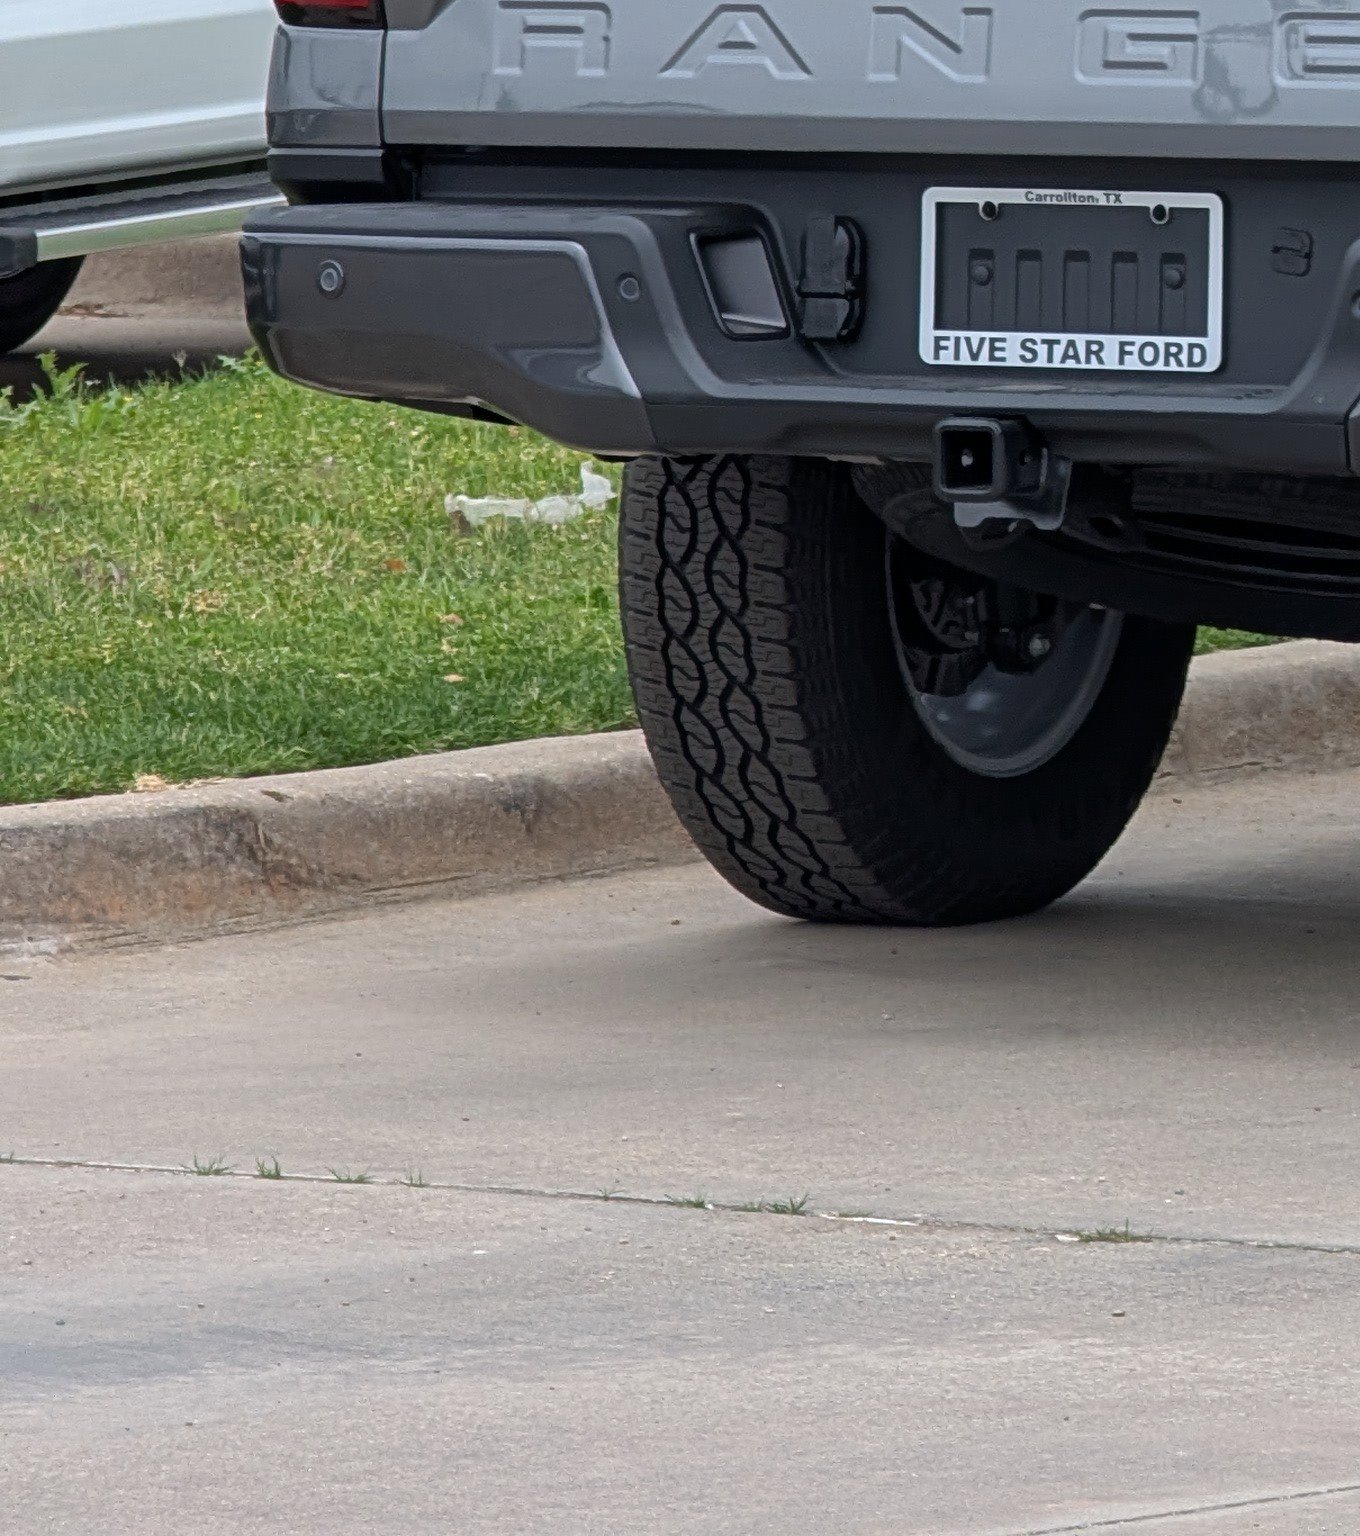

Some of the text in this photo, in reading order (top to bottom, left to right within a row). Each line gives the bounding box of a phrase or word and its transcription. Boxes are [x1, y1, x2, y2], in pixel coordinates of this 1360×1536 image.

[1024, 190, 1123, 205] Carrollton, TX
[932, 335, 1208, 369] FIVE STAR FORD
